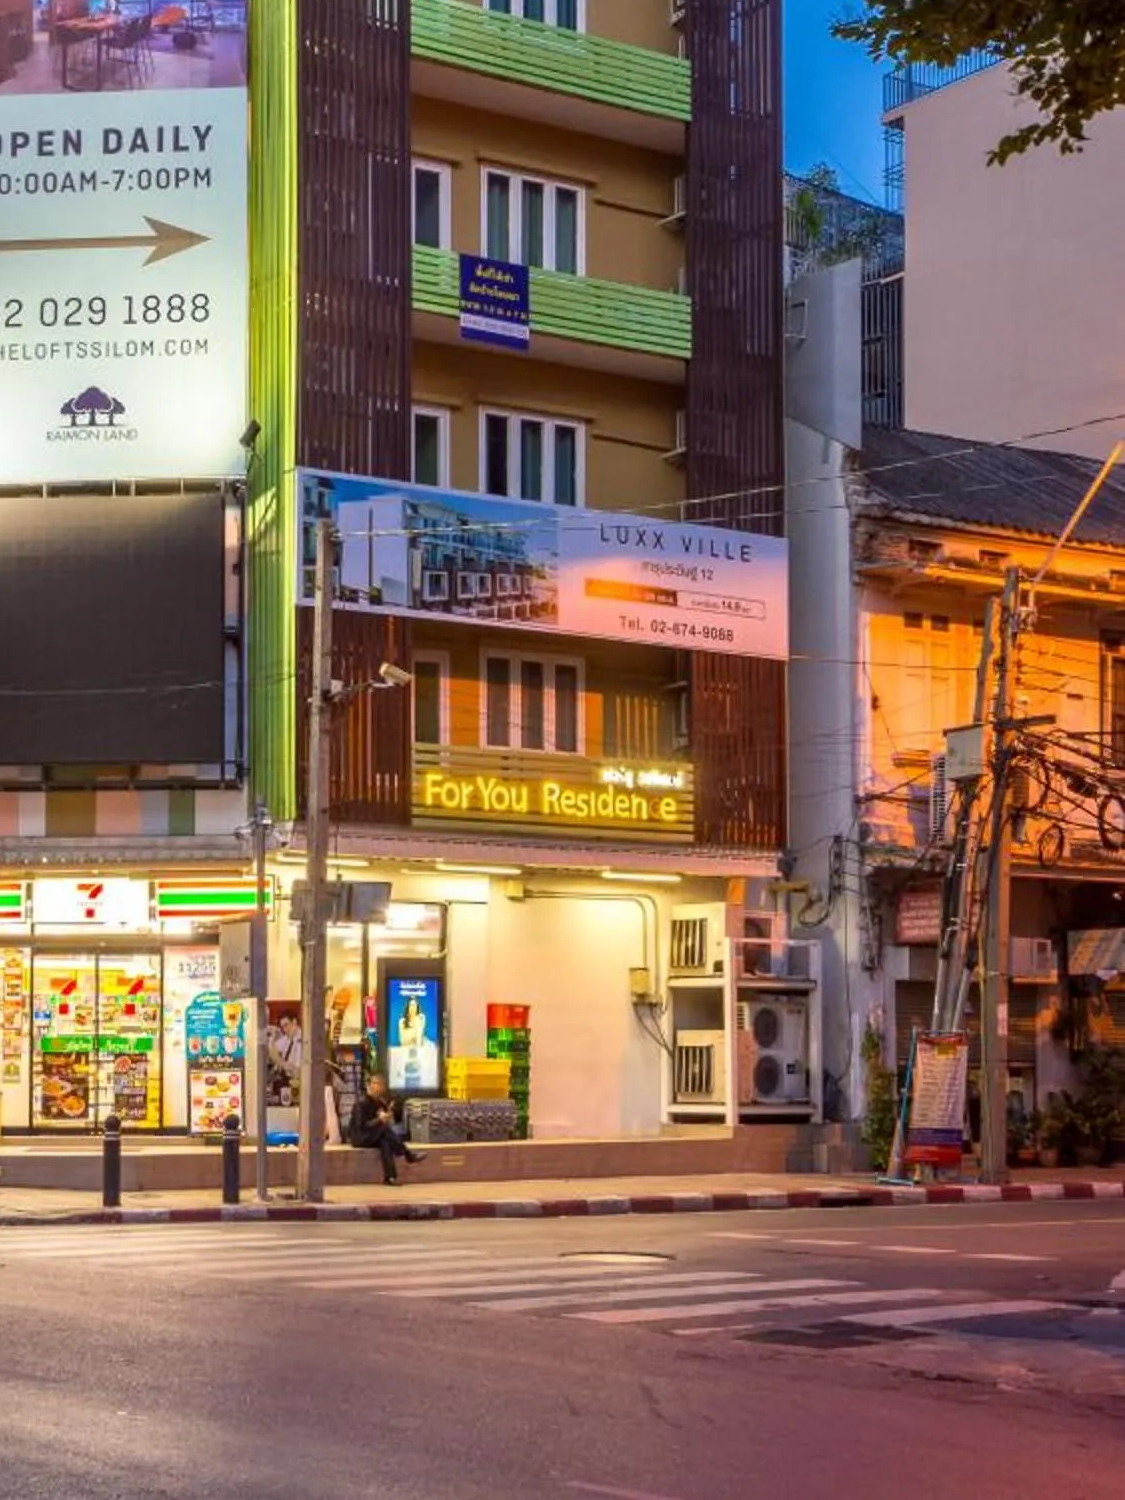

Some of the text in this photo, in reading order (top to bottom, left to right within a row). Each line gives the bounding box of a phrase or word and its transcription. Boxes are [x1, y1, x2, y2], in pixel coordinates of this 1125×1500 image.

[102, 124, 213, 154] DAILY
[39, 297, 107, 327] 029
[123, 293, 211, 325] 1888
[46, 428, 138, 441] RAIMON LAND
[600, 523, 752, 563] LUXX VILLE
